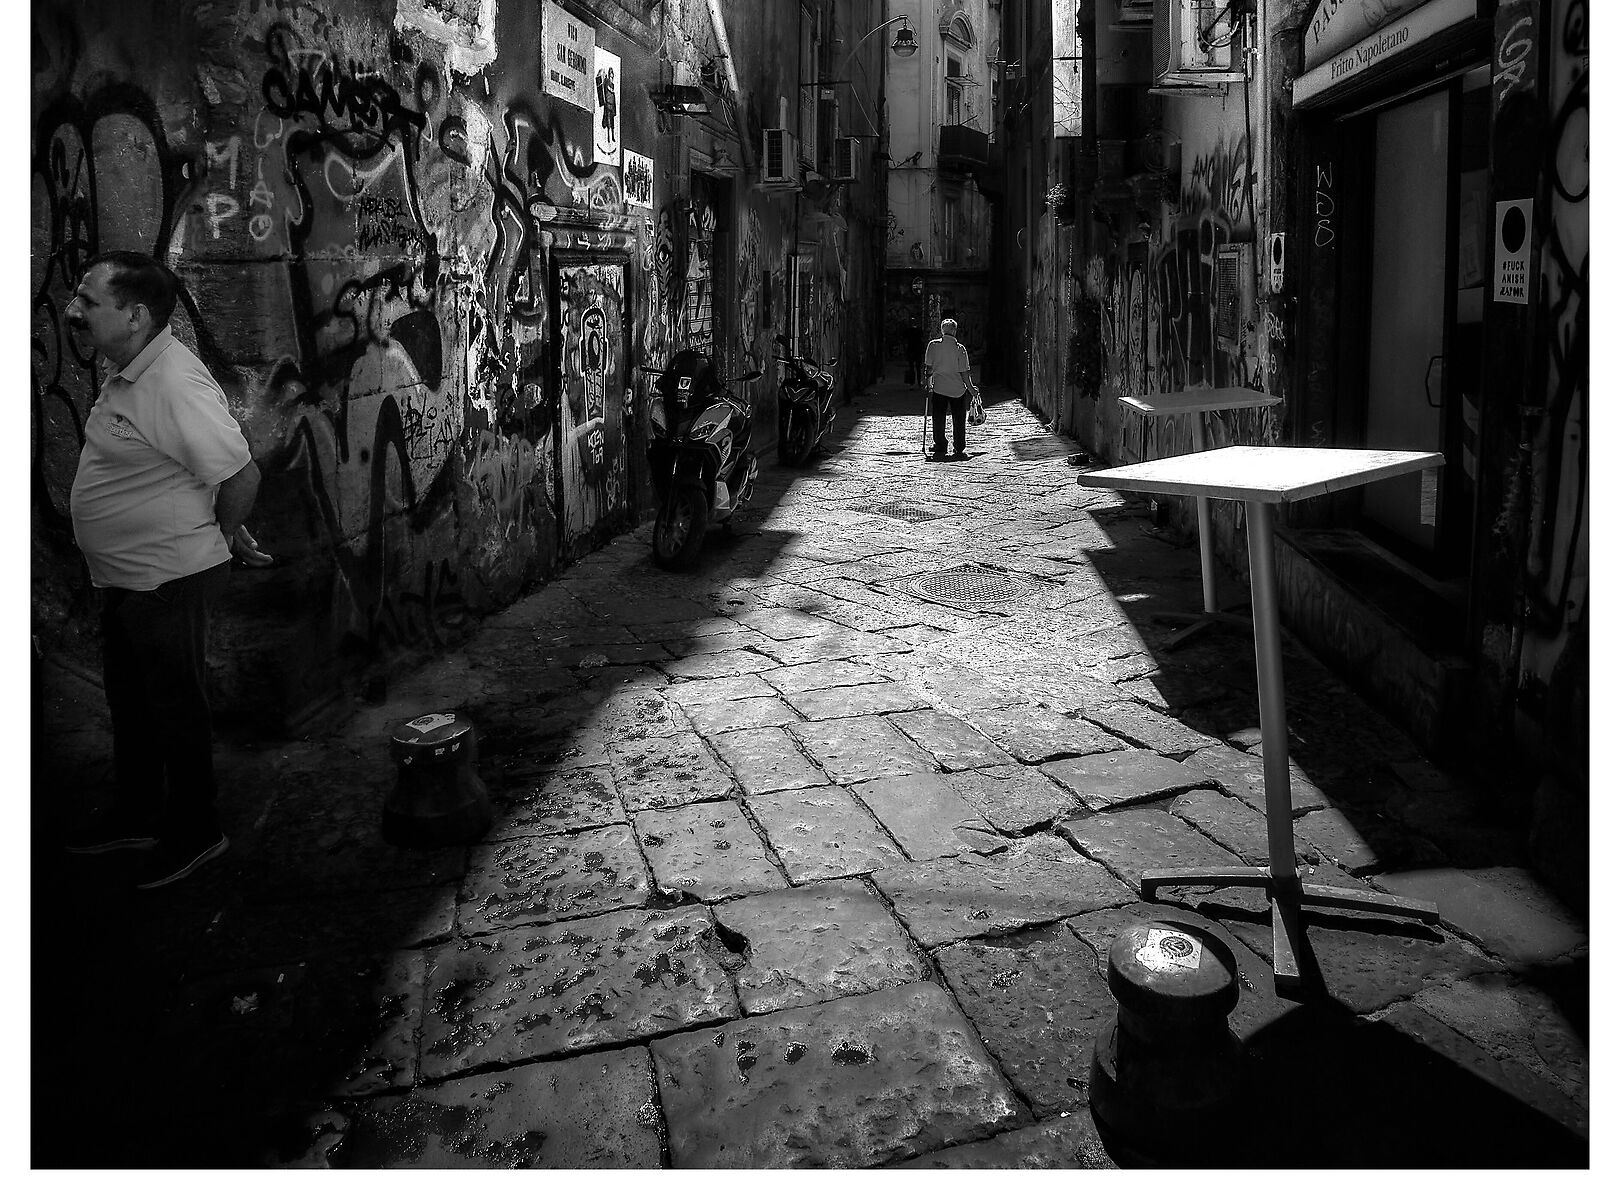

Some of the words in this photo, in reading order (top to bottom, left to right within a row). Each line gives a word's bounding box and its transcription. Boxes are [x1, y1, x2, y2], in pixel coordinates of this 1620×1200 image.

[1330, 56, 1354, 80] Fritto
[1355, 27, 1409, 68] Napoletano
[1502, 260, 1525, 272] #FUCK
[1501, 273, 1525, 285] ANISH
